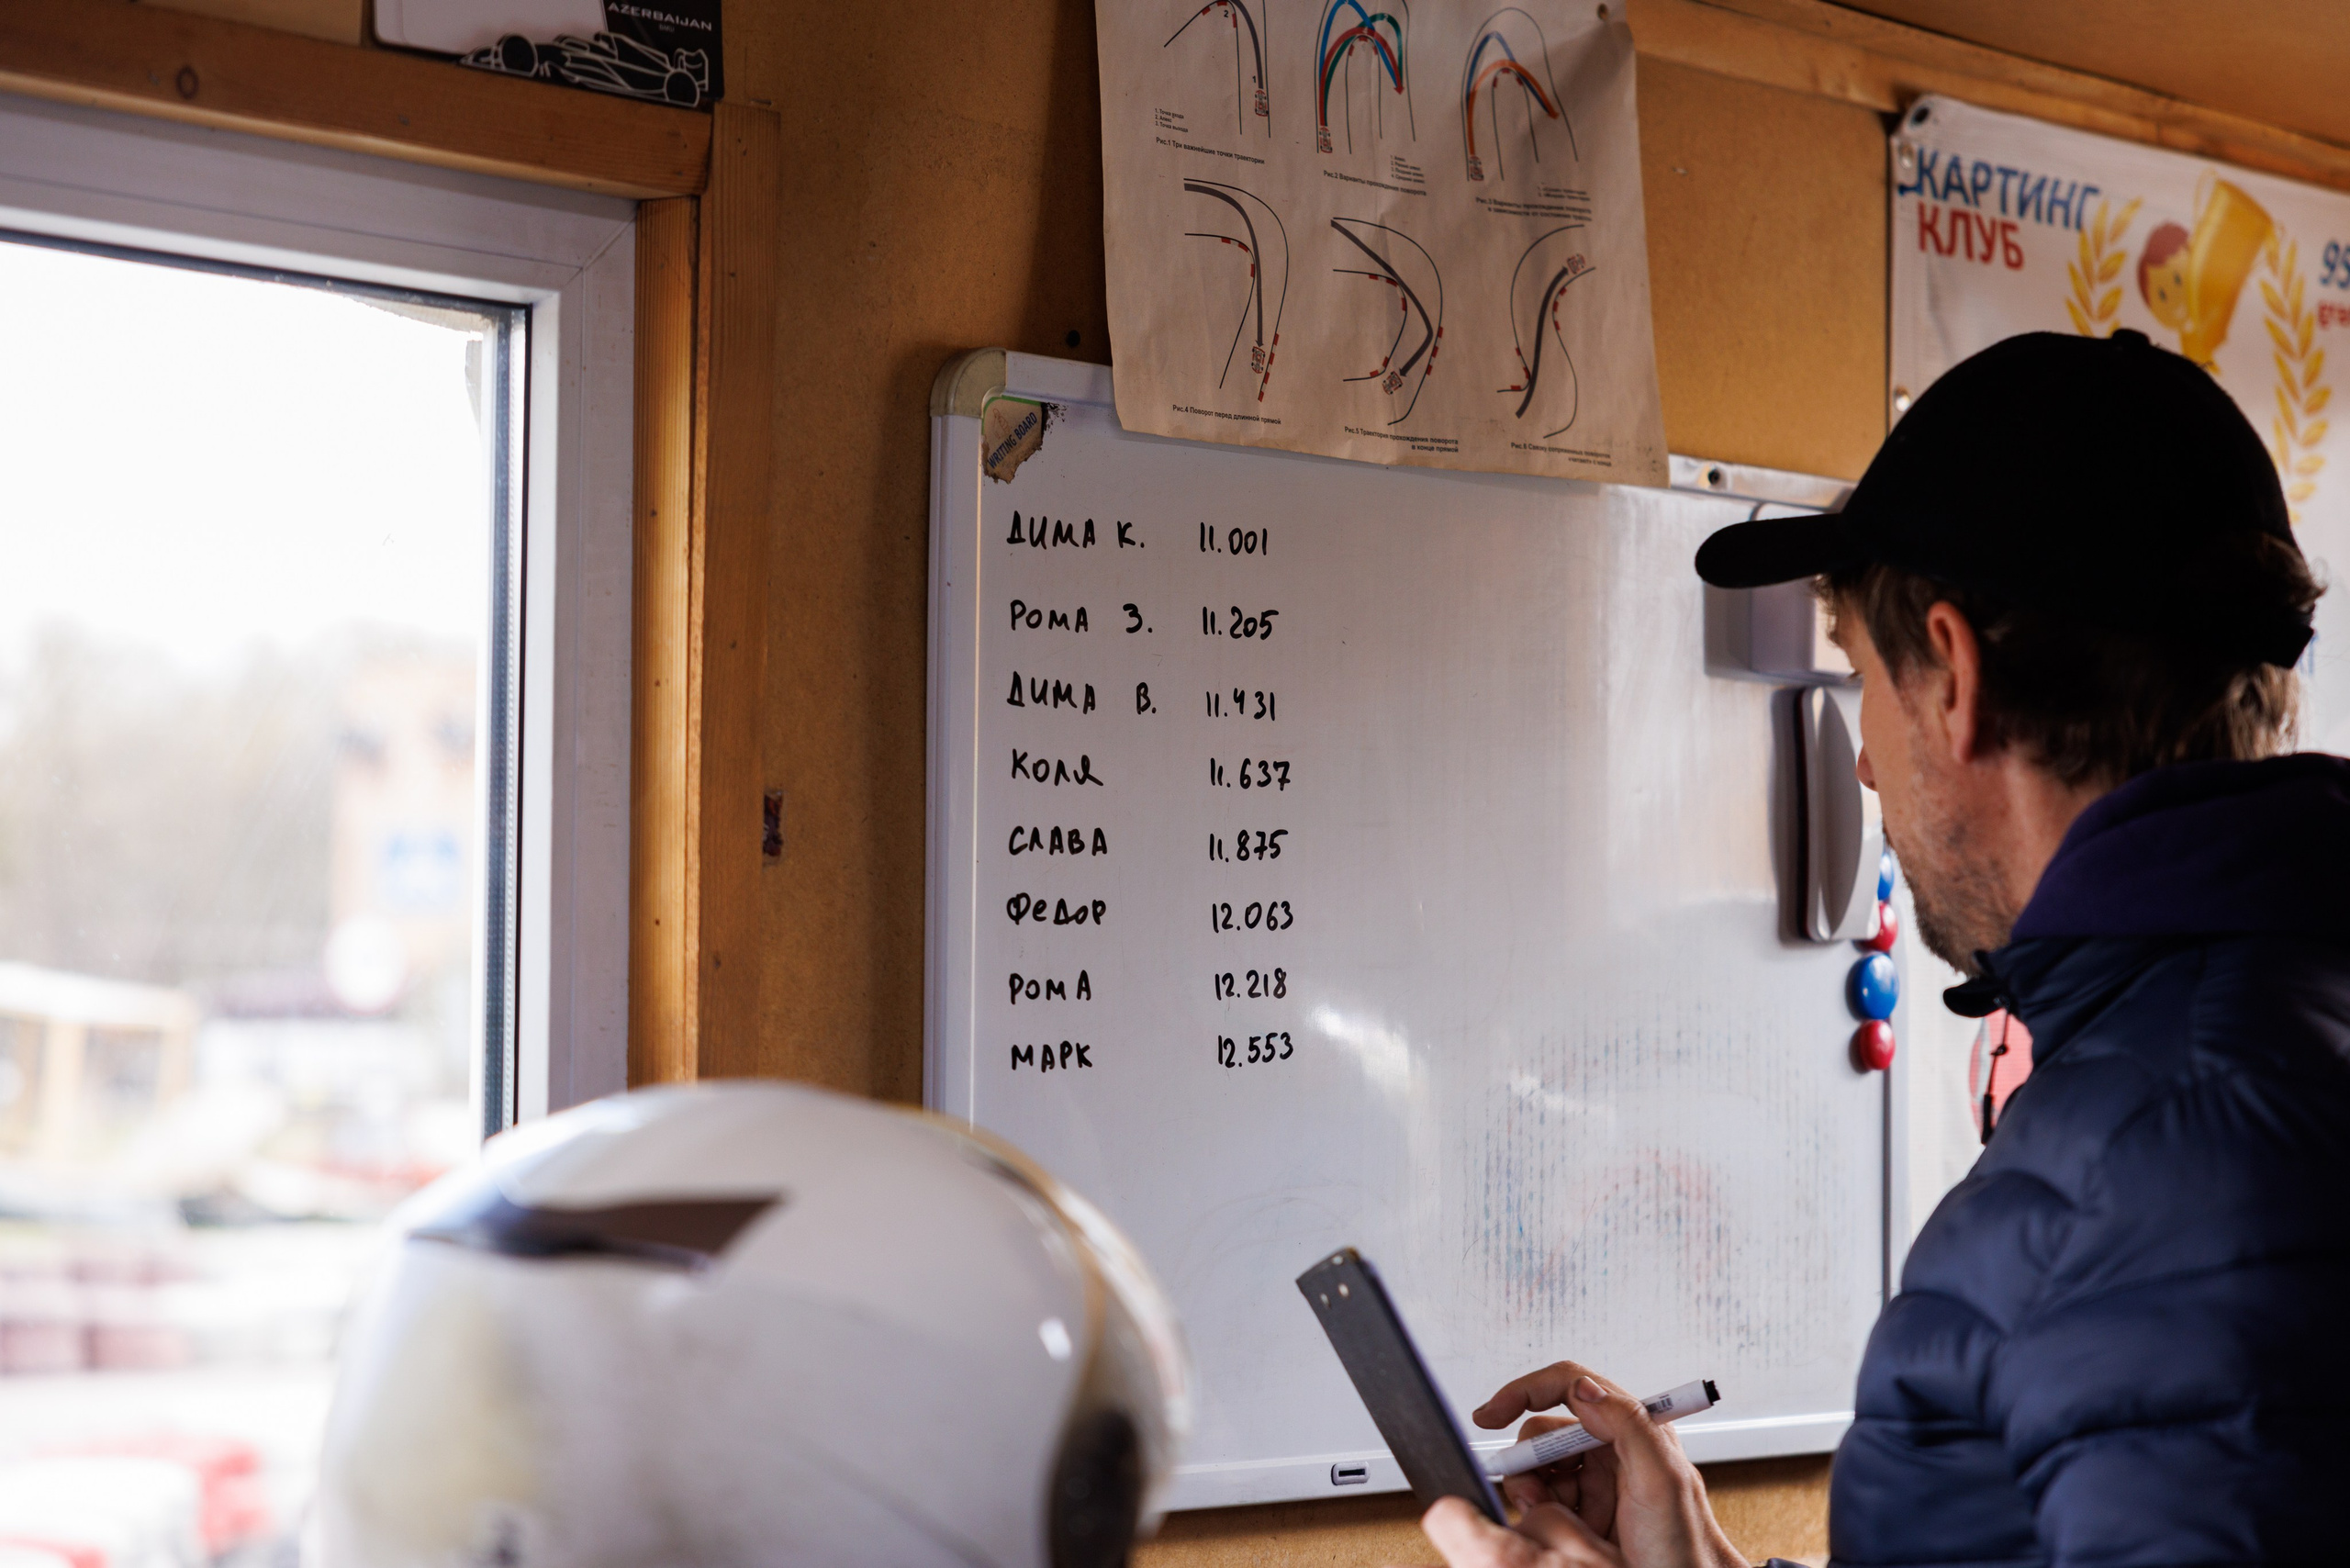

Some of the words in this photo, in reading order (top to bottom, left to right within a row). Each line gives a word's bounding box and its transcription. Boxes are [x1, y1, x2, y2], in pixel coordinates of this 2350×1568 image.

[608, 2, 712, 31] AZERBAIJAN
[1224, 10, 1229, 18] 2
[1172, 140, 1182, 150] Три
[1183, 144, 1215, 155] важнейшие
[1216, 151, 1234, 159] точки
[1234, 153, 1265, 165] траектории
[1917, 145, 2101, 234] КАРТИНГ
[1918, 200, 2026, 271] КЛУБ
[1172, 404, 1189, 413] Рис.4
[1190, 407, 1214, 417] Поворот
[1214, 410, 1232, 420] перед
[1233, 413, 1259, 422] длинной
[1260, 416, 1281, 425] прямой
[987, 434, 1017, 469] WRITING
[1013, 412, 1037, 441] BOARD
[1360, 428, 1389, 439] Траектория
[1389, 434, 1428, 442] прохождения
[1007, 510, 1095, 550] ДИМА
[1117, 521, 1145, 549] К.
[1199, 522, 1268, 556] 11.001
[1010, 599, 1089, 633] РОМА
[1202, 606, 1280, 641] 11.205
[1007, 671, 1096, 714] ДИМА
[1136, 682, 1157, 715] В.
[1205, 688, 1276, 722] 11.431
[1011, 748, 1104, 787] КОЛЯ
[1210, 756, 1292, 792] 11.637
[1008, 825, 1108, 856] СЛАВА
[1209, 829, 1289, 863] 11.875
[1212, 901, 1294, 935] 12.063
[1009, 969, 1091, 1005] РОМА
[1214, 967, 1287, 1002] 12.218
[1011, 1040, 1093, 1073] МАРК
[1217, 1032, 1294, 1069] 12.553
